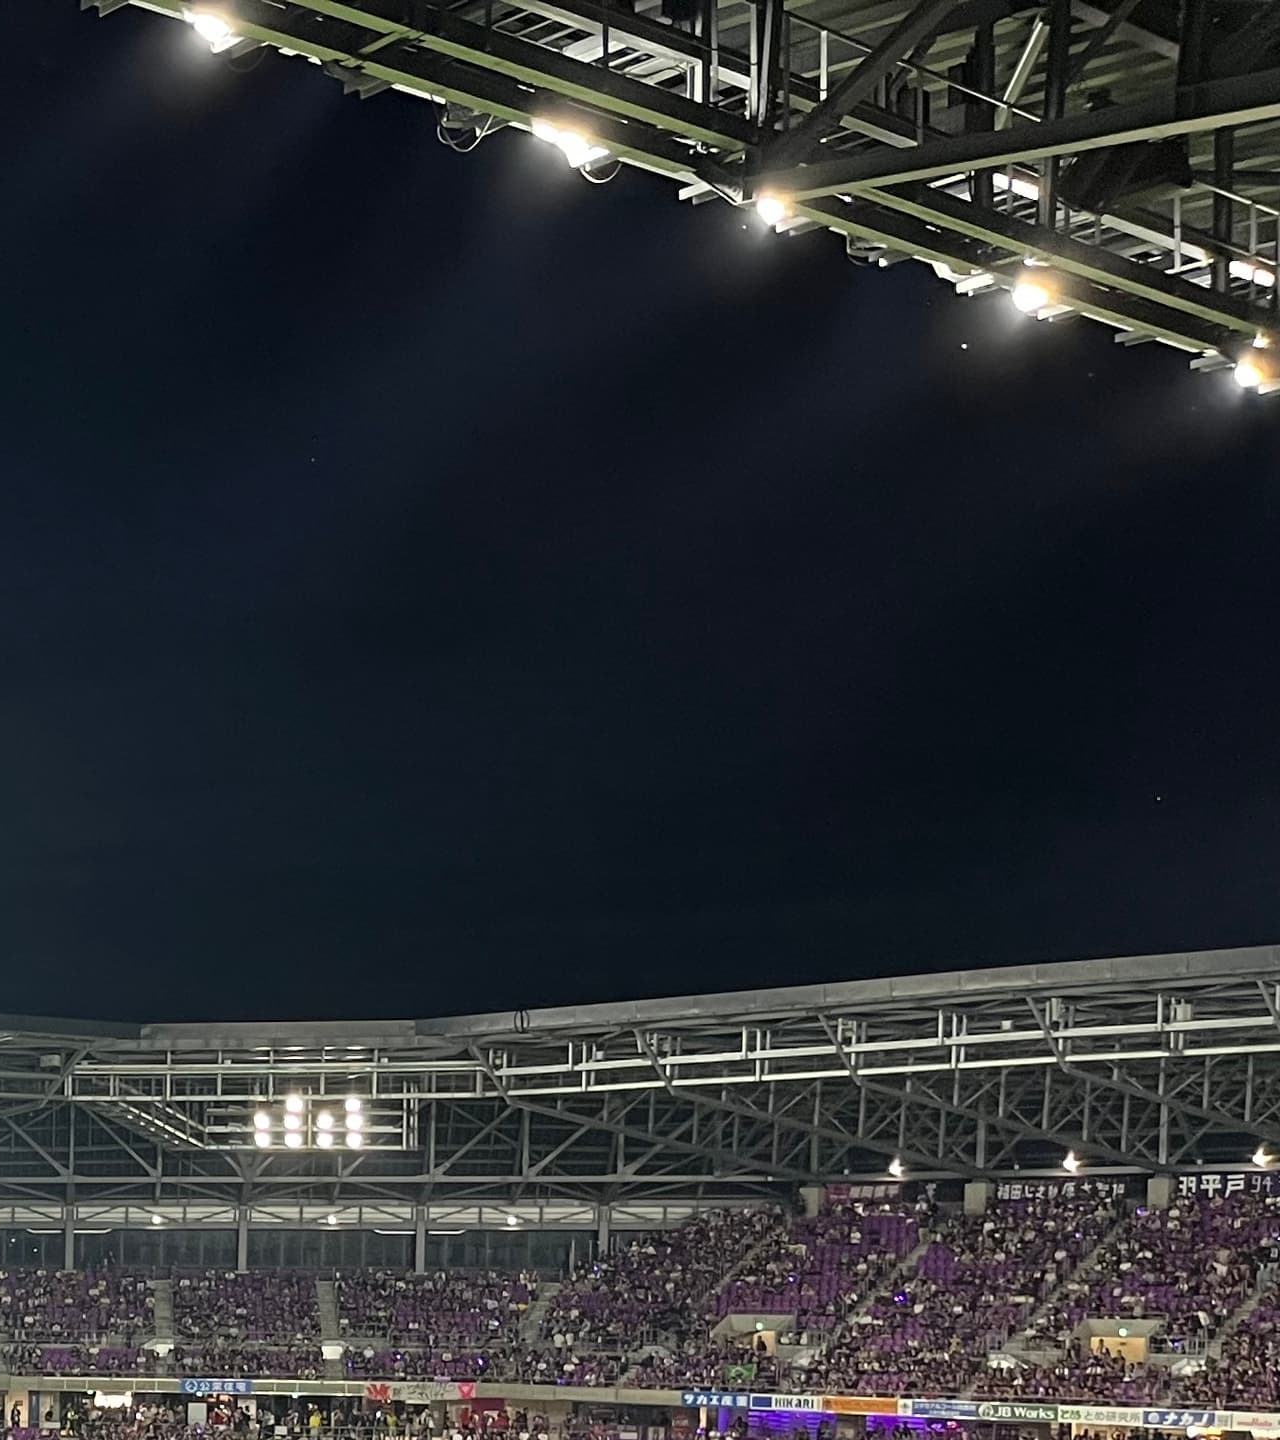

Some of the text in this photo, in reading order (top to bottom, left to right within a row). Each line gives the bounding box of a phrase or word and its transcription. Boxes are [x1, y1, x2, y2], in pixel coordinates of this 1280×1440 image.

[1200, 1174, 1245, 1198] 平戸
[994, 1406, 1056, 1420] JB Works
